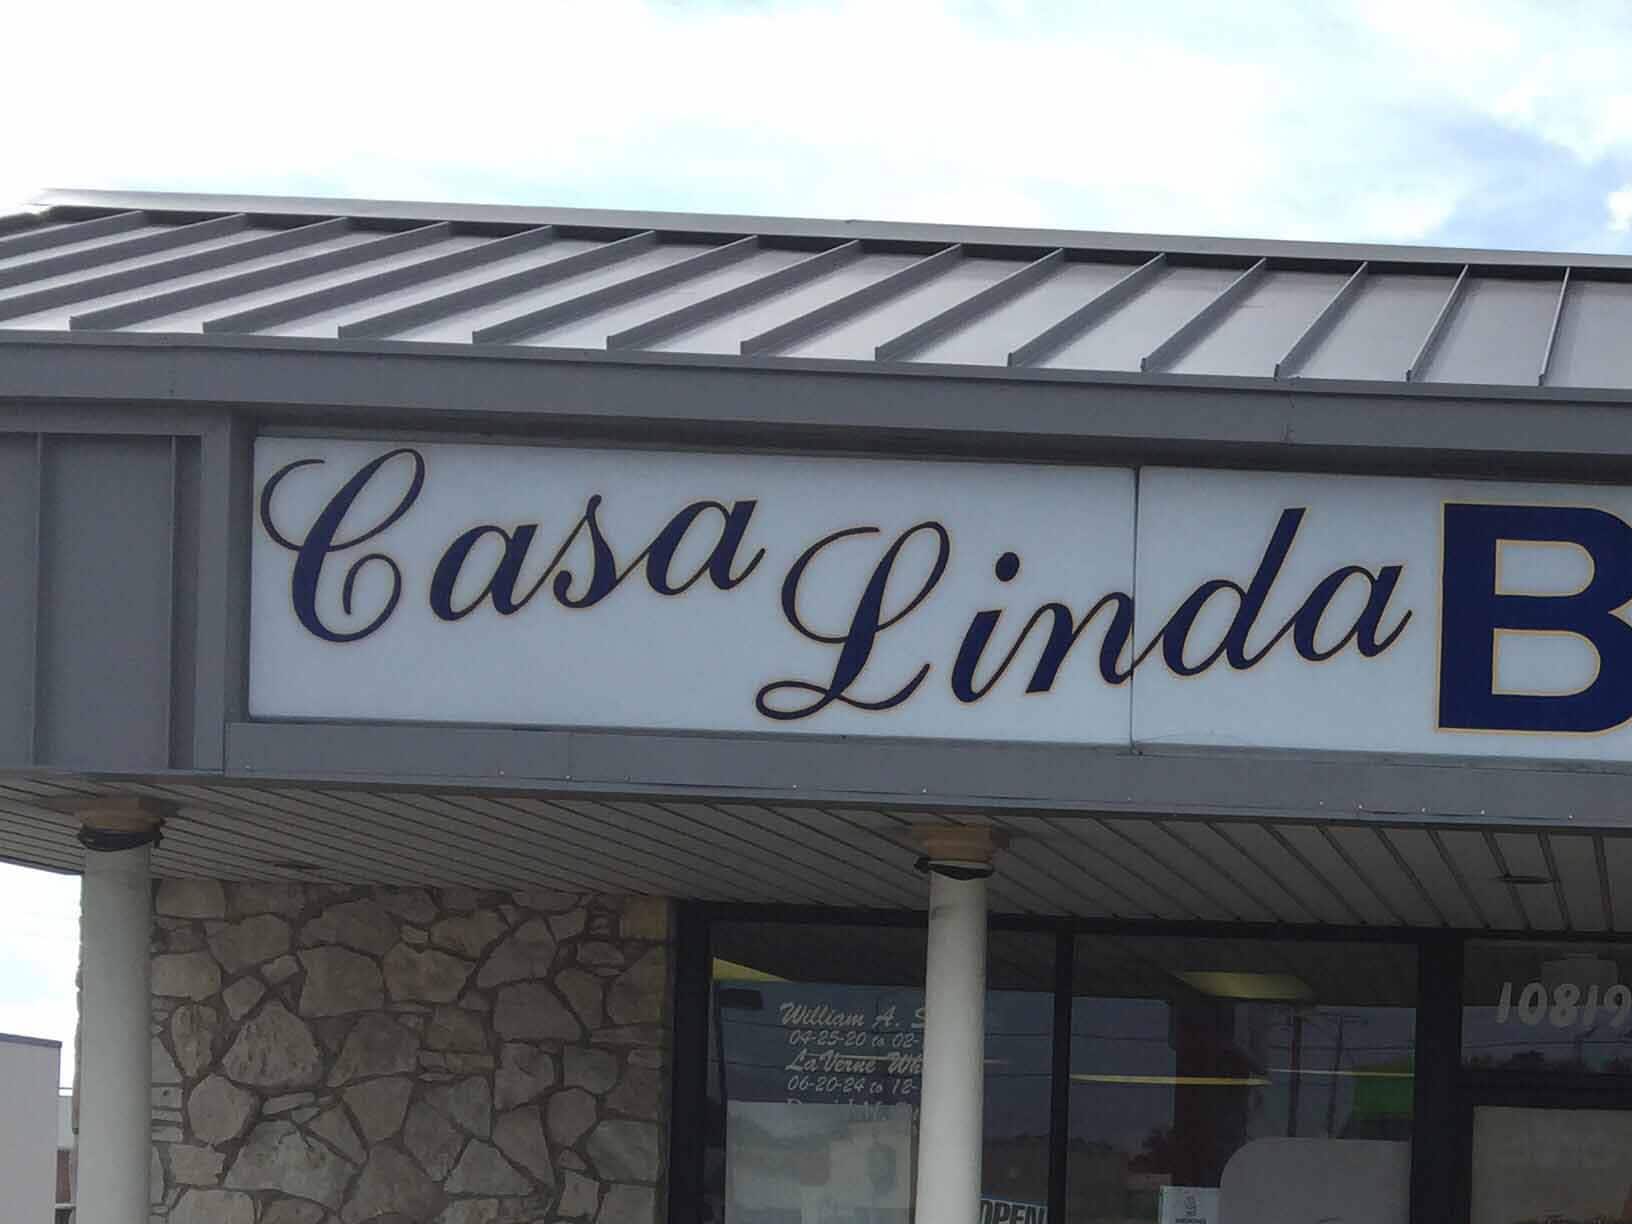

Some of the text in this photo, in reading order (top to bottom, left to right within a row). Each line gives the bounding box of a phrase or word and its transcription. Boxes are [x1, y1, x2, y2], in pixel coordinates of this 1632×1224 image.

[258, 447, 767, 644] Casa
[754, 506, 1414, 722] Linda
[780, 1001, 865, 1027] William
[1495, 981, 1632, 1029] 10819
